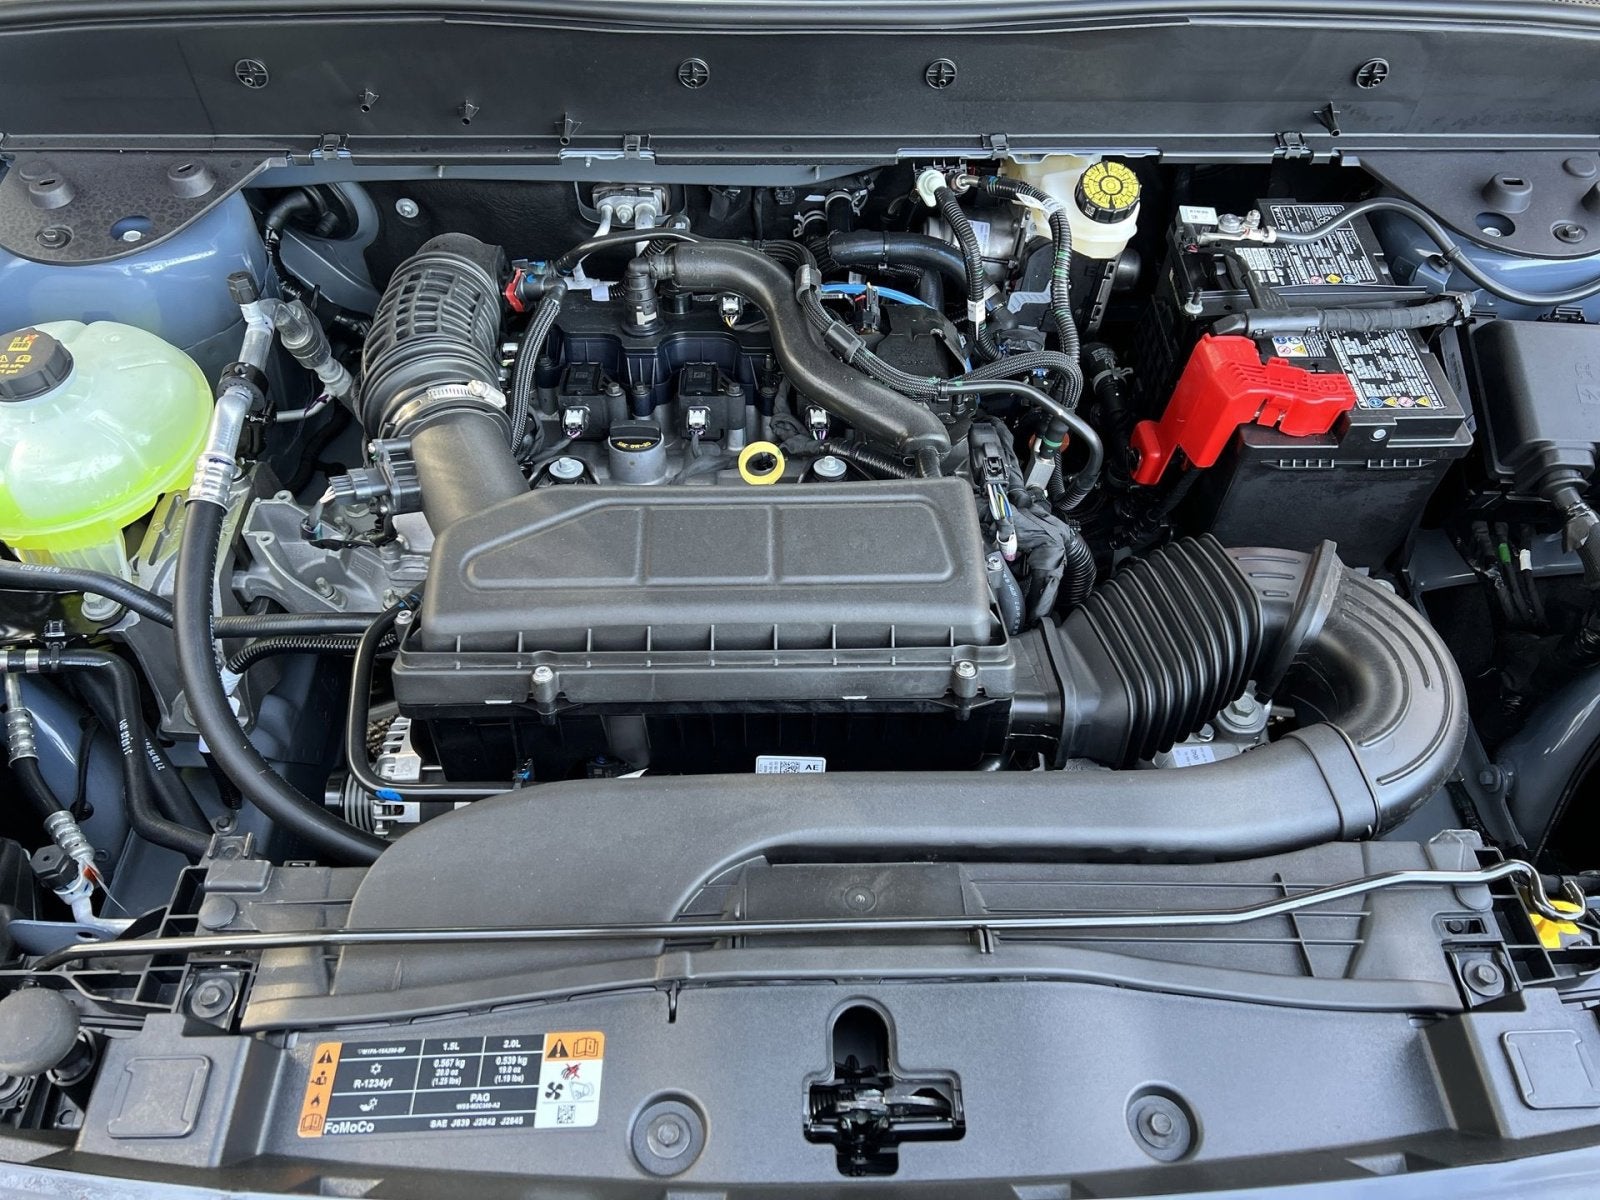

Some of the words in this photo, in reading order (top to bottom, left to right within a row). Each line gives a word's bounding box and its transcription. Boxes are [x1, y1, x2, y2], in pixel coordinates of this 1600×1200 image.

[443, 1042, 460, 1051] 1.5L
[503, 1039, 521, 1048] 2.0L
[455, 1058, 466, 1069] kg
[517, 1056, 528, 1066] kg
[353, 1077, 394, 1089] R-1234yf
[469, 1093, 490, 1102] PAG
[324, 1121, 374, 1134] FoMoCo
[430, 1119, 448, 1128] SAE
[450, 1118, 470, 1127] J639
